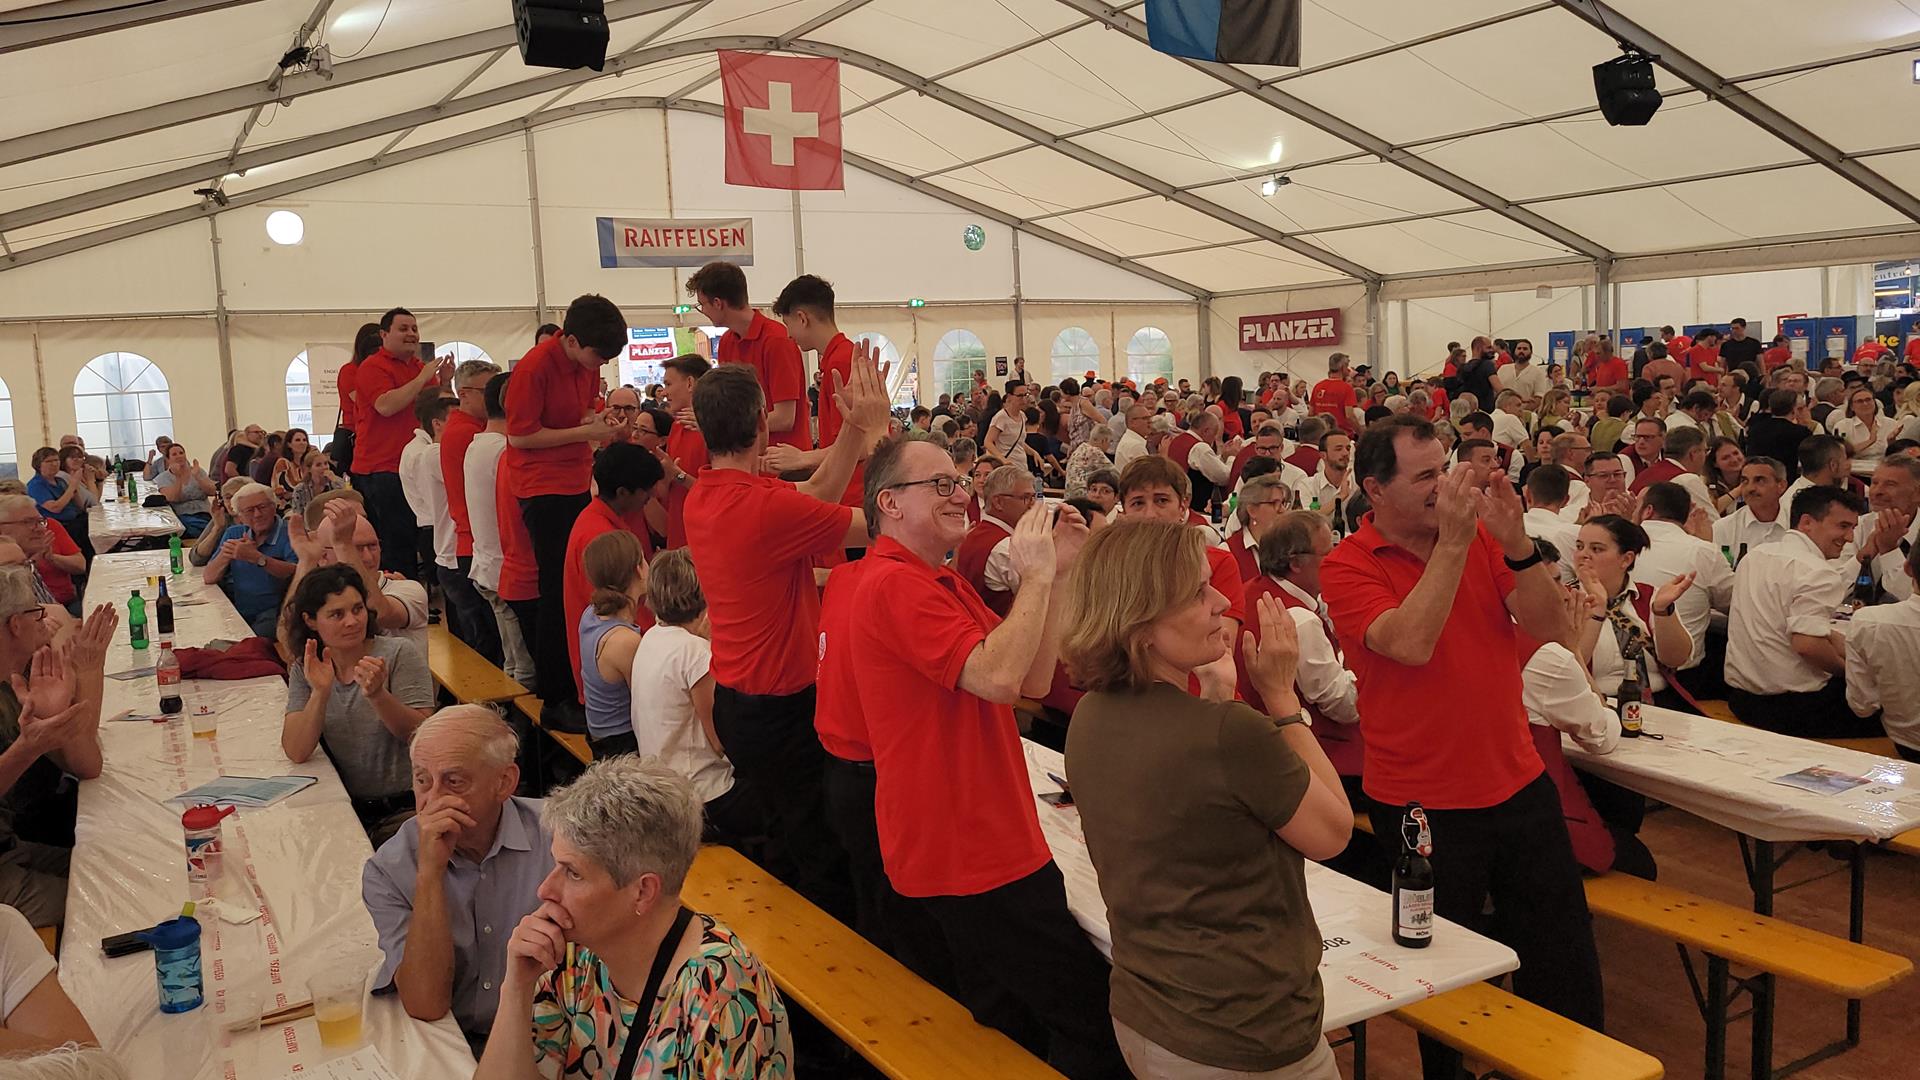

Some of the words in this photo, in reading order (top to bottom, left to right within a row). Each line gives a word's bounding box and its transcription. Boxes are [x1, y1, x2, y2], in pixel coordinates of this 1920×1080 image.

[624, 228, 745, 248] RAIFFEISEN
[1243, 317, 1335, 343] PLANZER
[283, 1026, 299, 1054] RAIFFEISEN
